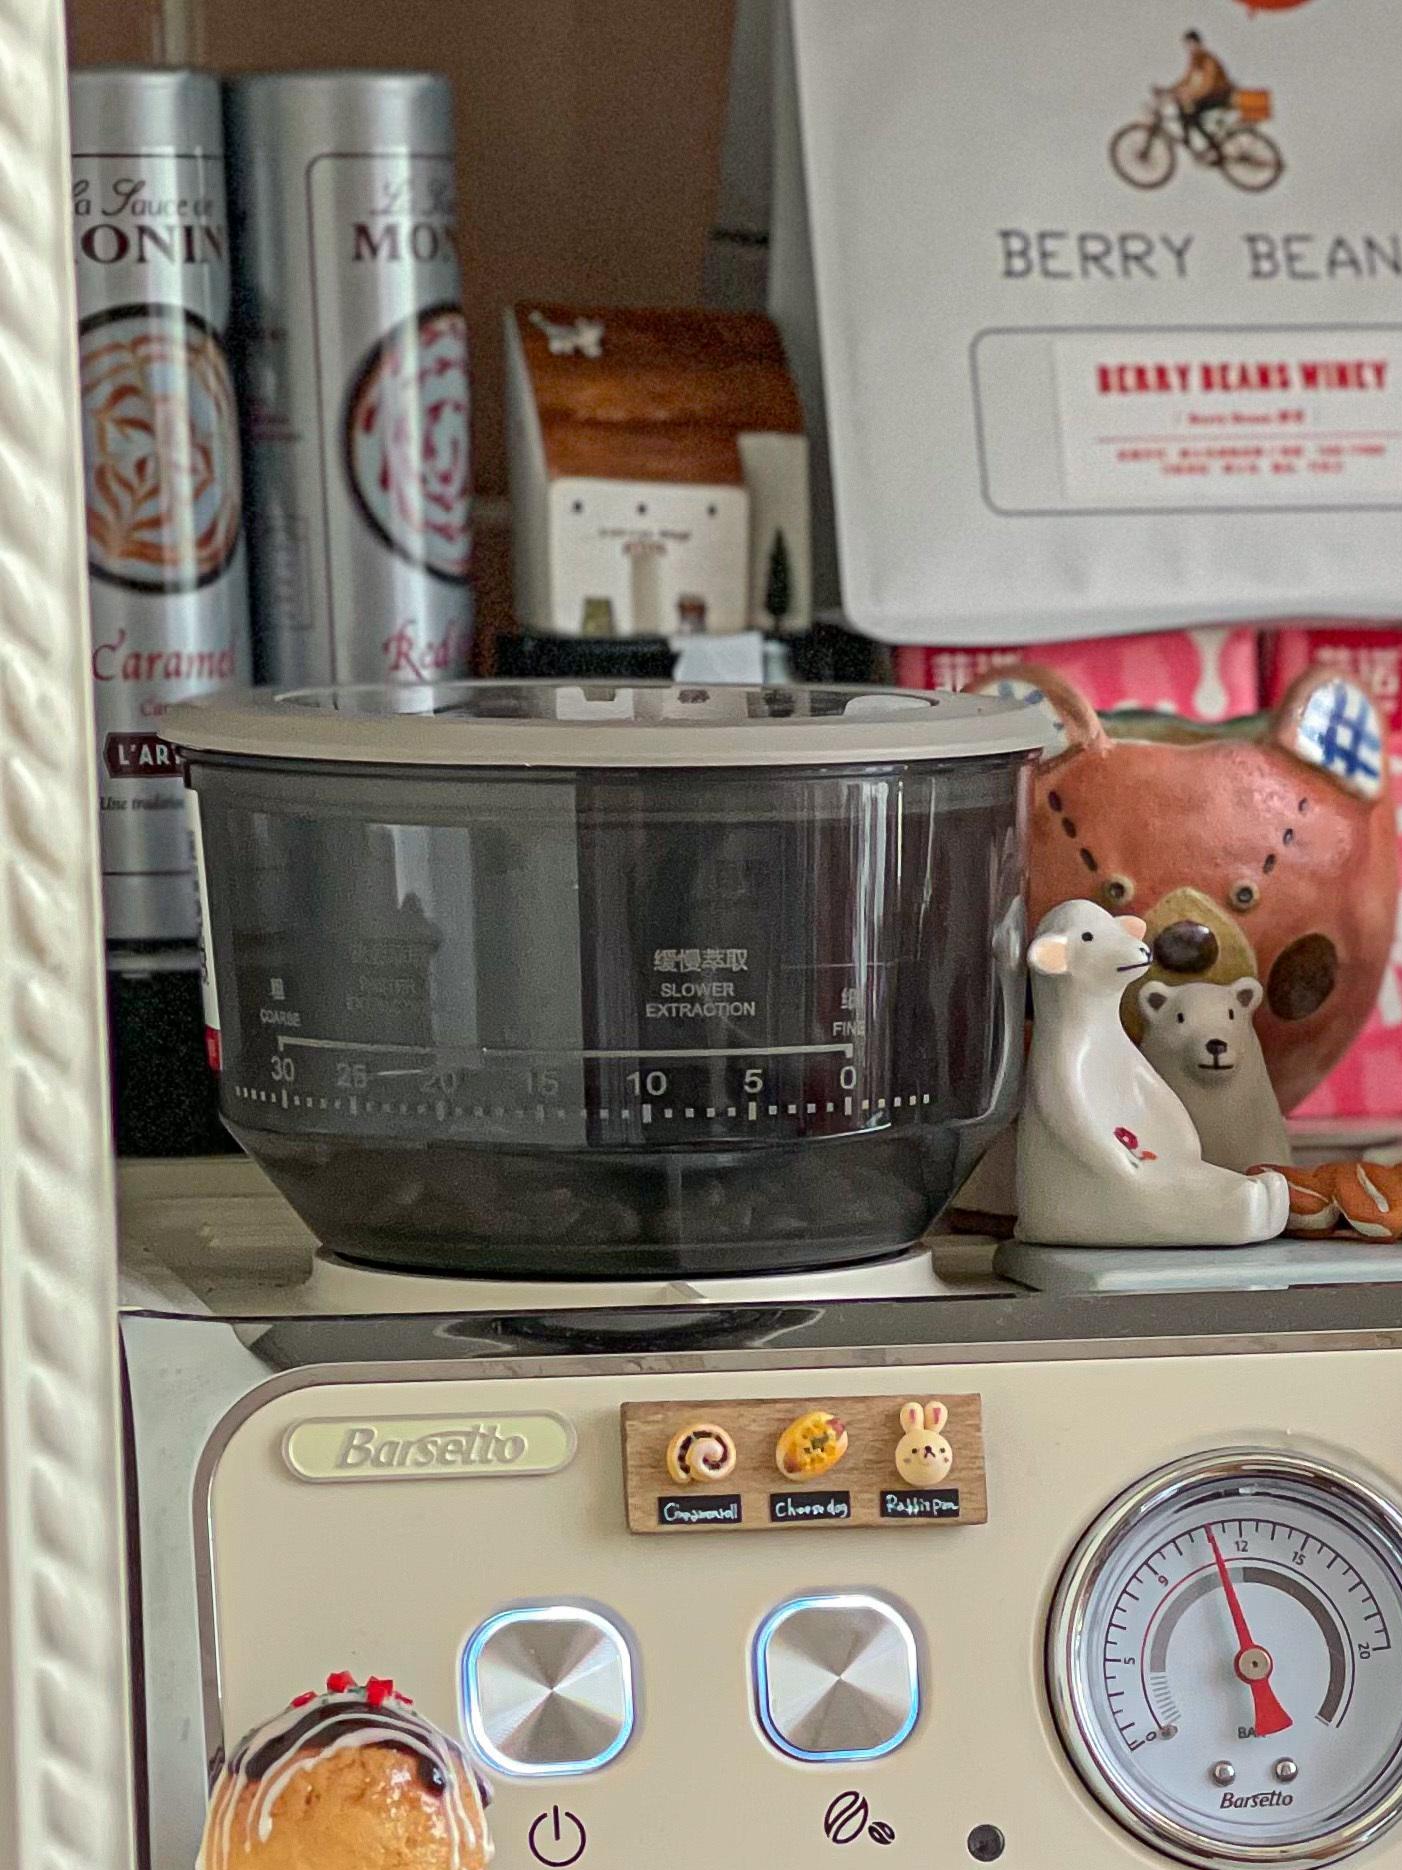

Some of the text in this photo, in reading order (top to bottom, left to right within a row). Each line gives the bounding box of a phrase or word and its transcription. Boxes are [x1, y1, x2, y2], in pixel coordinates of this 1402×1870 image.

[73, 223, 226, 265] ONIN
[996, 228, 1195, 281] BERRY
[1097, 363, 1190, 393] BERRY
[1200, 361, 1291, 392] BEANS
[92, 628, 236, 681] Caramel
[653, 948, 748, 972] 缓慢萃取
[660, 982, 735, 998] SLOWER
[260, 1008, 301, 1027] COARSE
[645, 1001, 756, 1018] EXTRACTION
[832, 1021, 865, 1037] FINE
[270, 1055, 295, 1082] 30
[626, 1070, 668, 1097] 10
[743, 1069, 763, 1094] 5
[839, 1065, 857, 1090] 0
[336, 1424, 528, 1469] Barsetto
[1234, 1540, 1249, 1552] 12
[1291, 1551, 1306, 1566] 15
[1158, 1575, 1169, 1587] 9
[1357, 1642, 1371, 1660] 20
[1123, 1656, 1136, 1665] 5
[1237, 1726, 1266, 1739] BA
[1219, 1790, 1294, 1809] Barsetto
